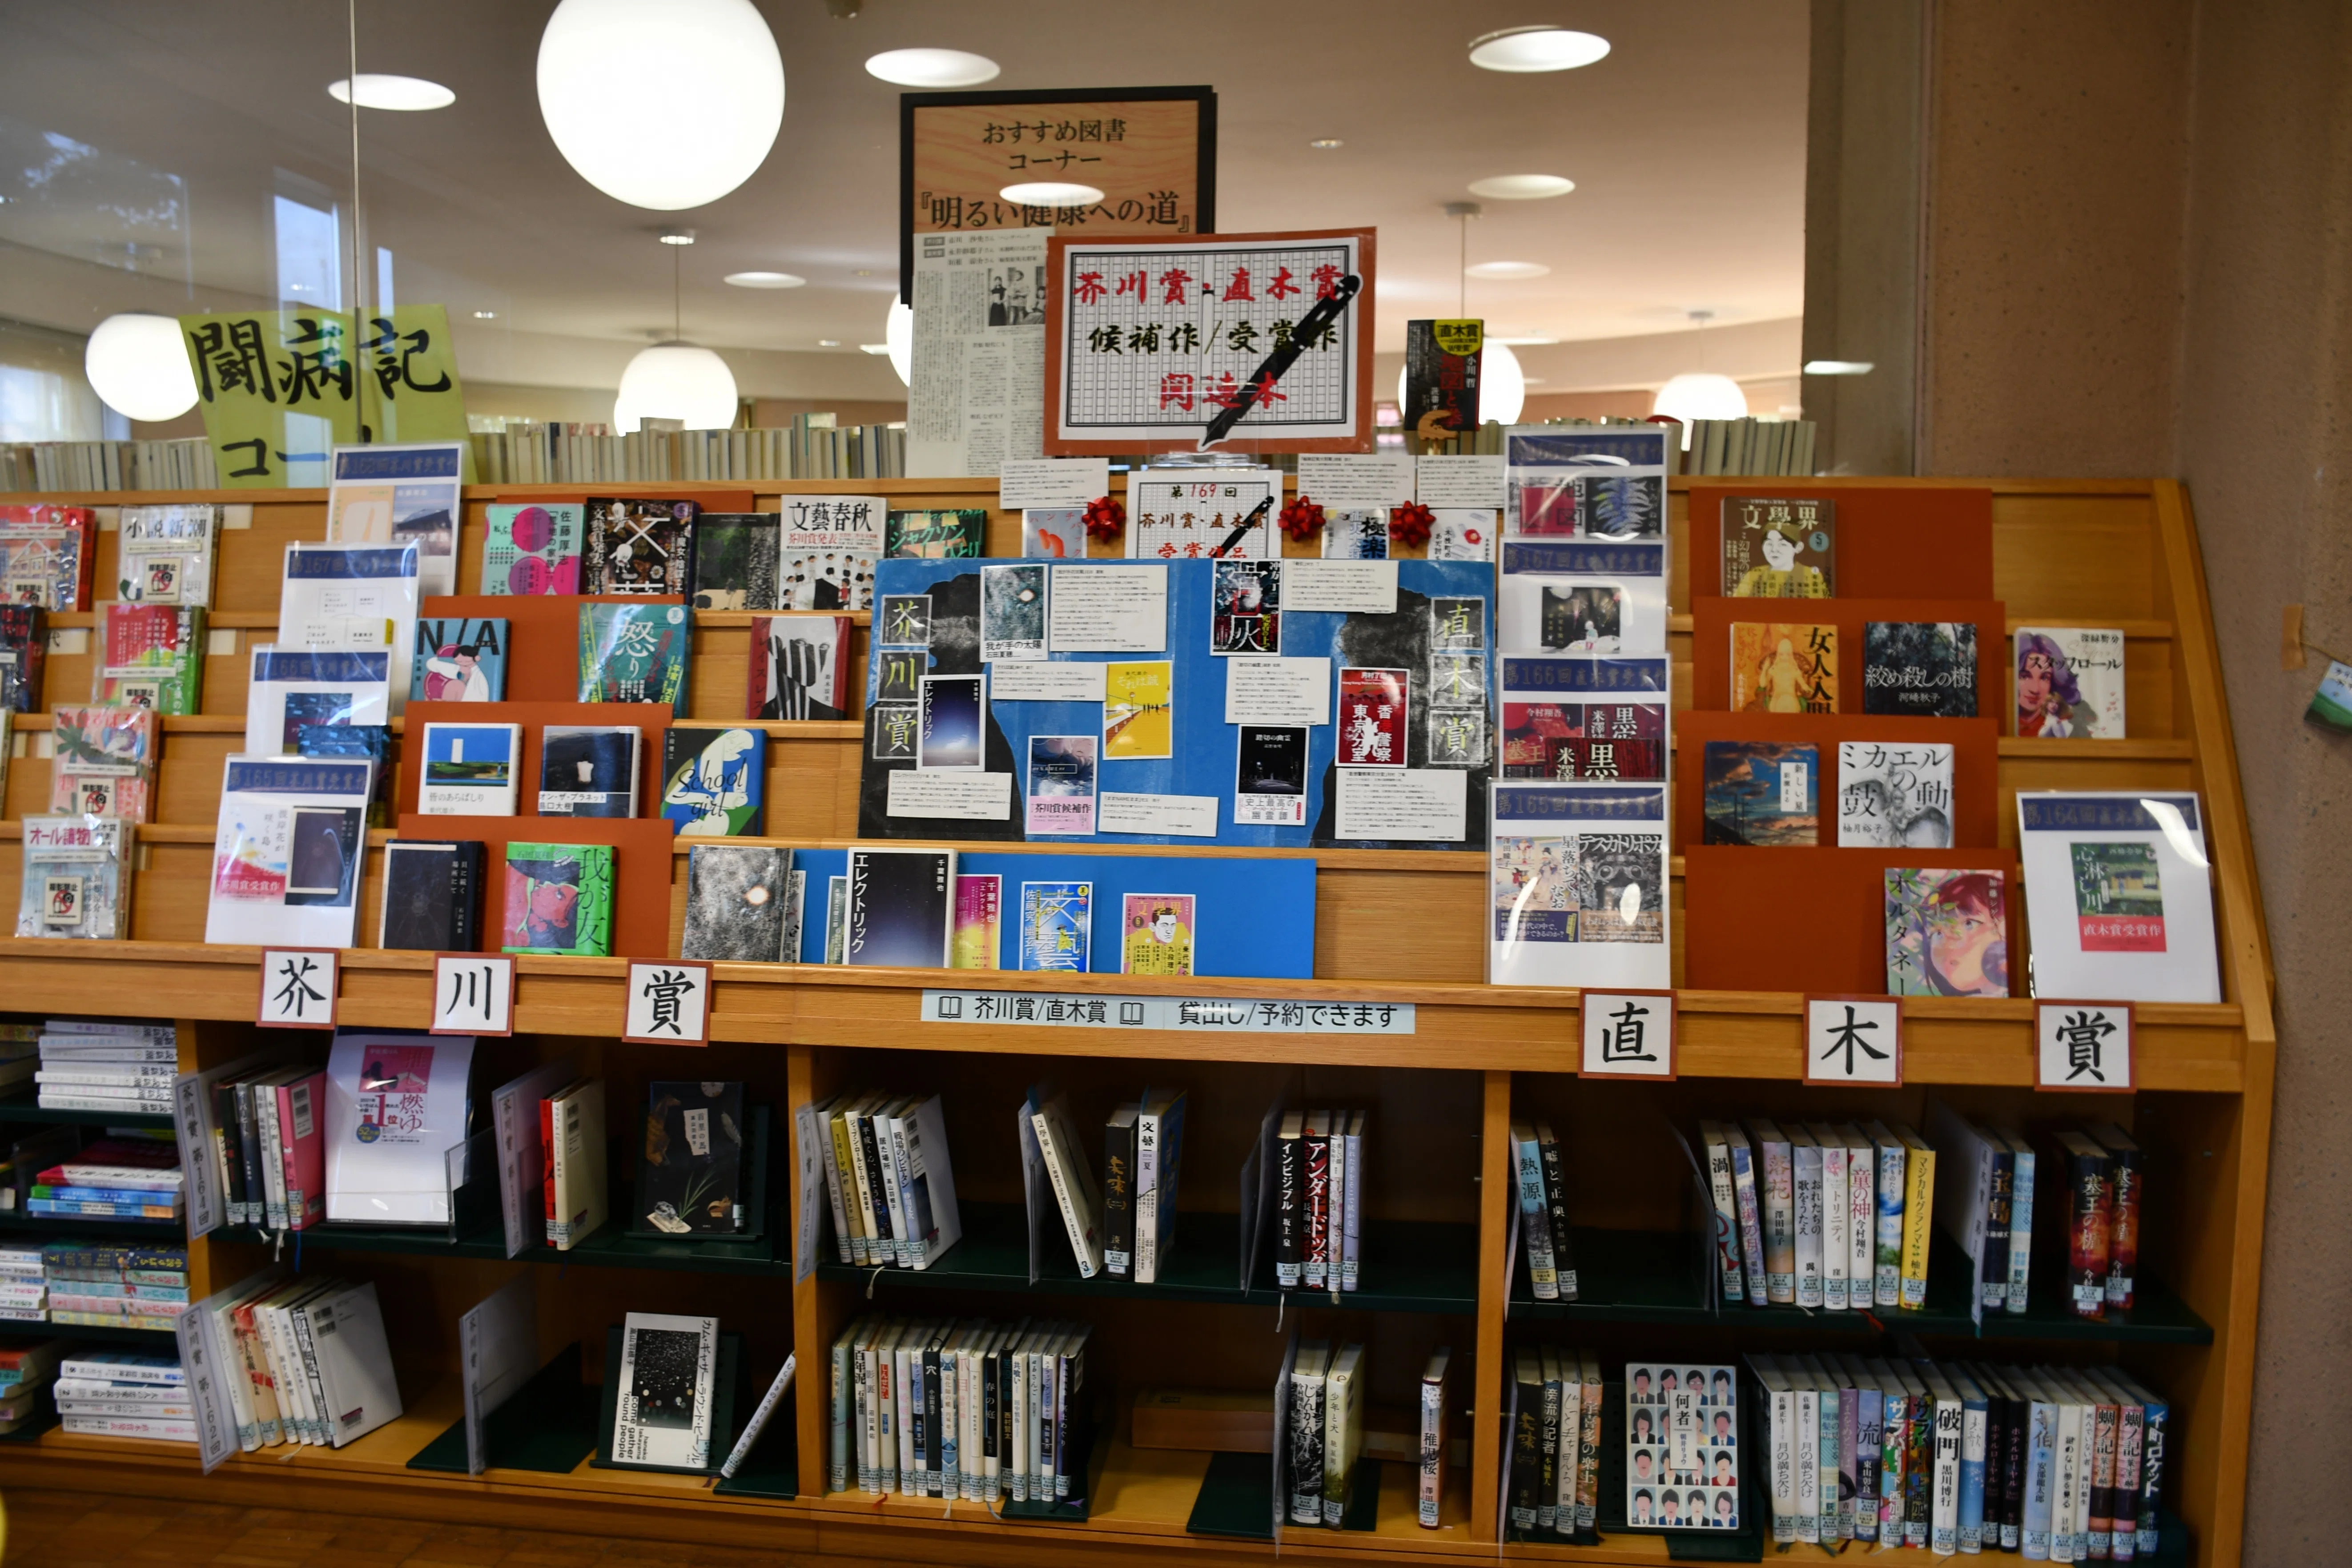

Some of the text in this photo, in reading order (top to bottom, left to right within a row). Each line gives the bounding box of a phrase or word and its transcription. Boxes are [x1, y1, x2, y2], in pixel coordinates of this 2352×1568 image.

[983, 120, 1126, 143] おすすめ図書
[1009, 151, 1102, 170] コーナー
[788, 502, 872, 532] 文藝春秋
[559, 511, 571, 566] 佐藤厚志
[788, 534, 837, 544] 芥川賞発表
[417, 619, 501, 655] N/A
[890, 601, 926, 637] 芥
[616, 621, 659, 677] 怒り
[886, 658, 915, 691] 川
[1435, 660, 1479, 699] 木
[1866, 665, 1972, 688] 絞め殺しの樹
[924, 682, 933, 740] エレクトリック
[885, 713, 917, 752] 賞
[1843, 744, 1950, 770] ミカエル
[677, 759, 747, 798] School
[690, 797, 726, 821] girl
[1580, 835, 1662, 853] テスカトリポカ
[852, 855, 869, 953] エレクトリック
[987, 882, 996, 922] 千葉雅也
[2083, 924, 2161, 938] 直木賞受賞作
[273, 958, 326, 1017] 芥
[447, 967, 491, 1020] 川
[643, 971, 696, 1034] 賞
[974, 997, 1398, 1028] 芥川賞/直木賞 貸出し/予約できます
[1602, 1002, 1657, 1063] 直
[1821, 1005, 1889, 1074] 木
[2056, 1012, 2115, 1082] 賞
[1282, 1143, 1294, 1210] インビジブル
[1520, 1158, 1541, 1199] 熱源
[1713, 1158, 1728, 1174] 渦
[1811, 1180, 1821, 1234] おれたちの
[1851, 1168, 1870, 1219] 童の神
[926, 1366, 937, 1375] 穴
[1675, 1395, 1691, 1425] 何者
[1858, 1421, 1880, 1445] 流
[1777, 1443, 1789, 1498] 月の満ち欠け
[1801, 1443, 1813, 1498] 月の満ち欠け
[1938, 1408, 1961, 1506] 破門 黒川博行
[2145, 1411, 2165, 1498] 下町ロケット
